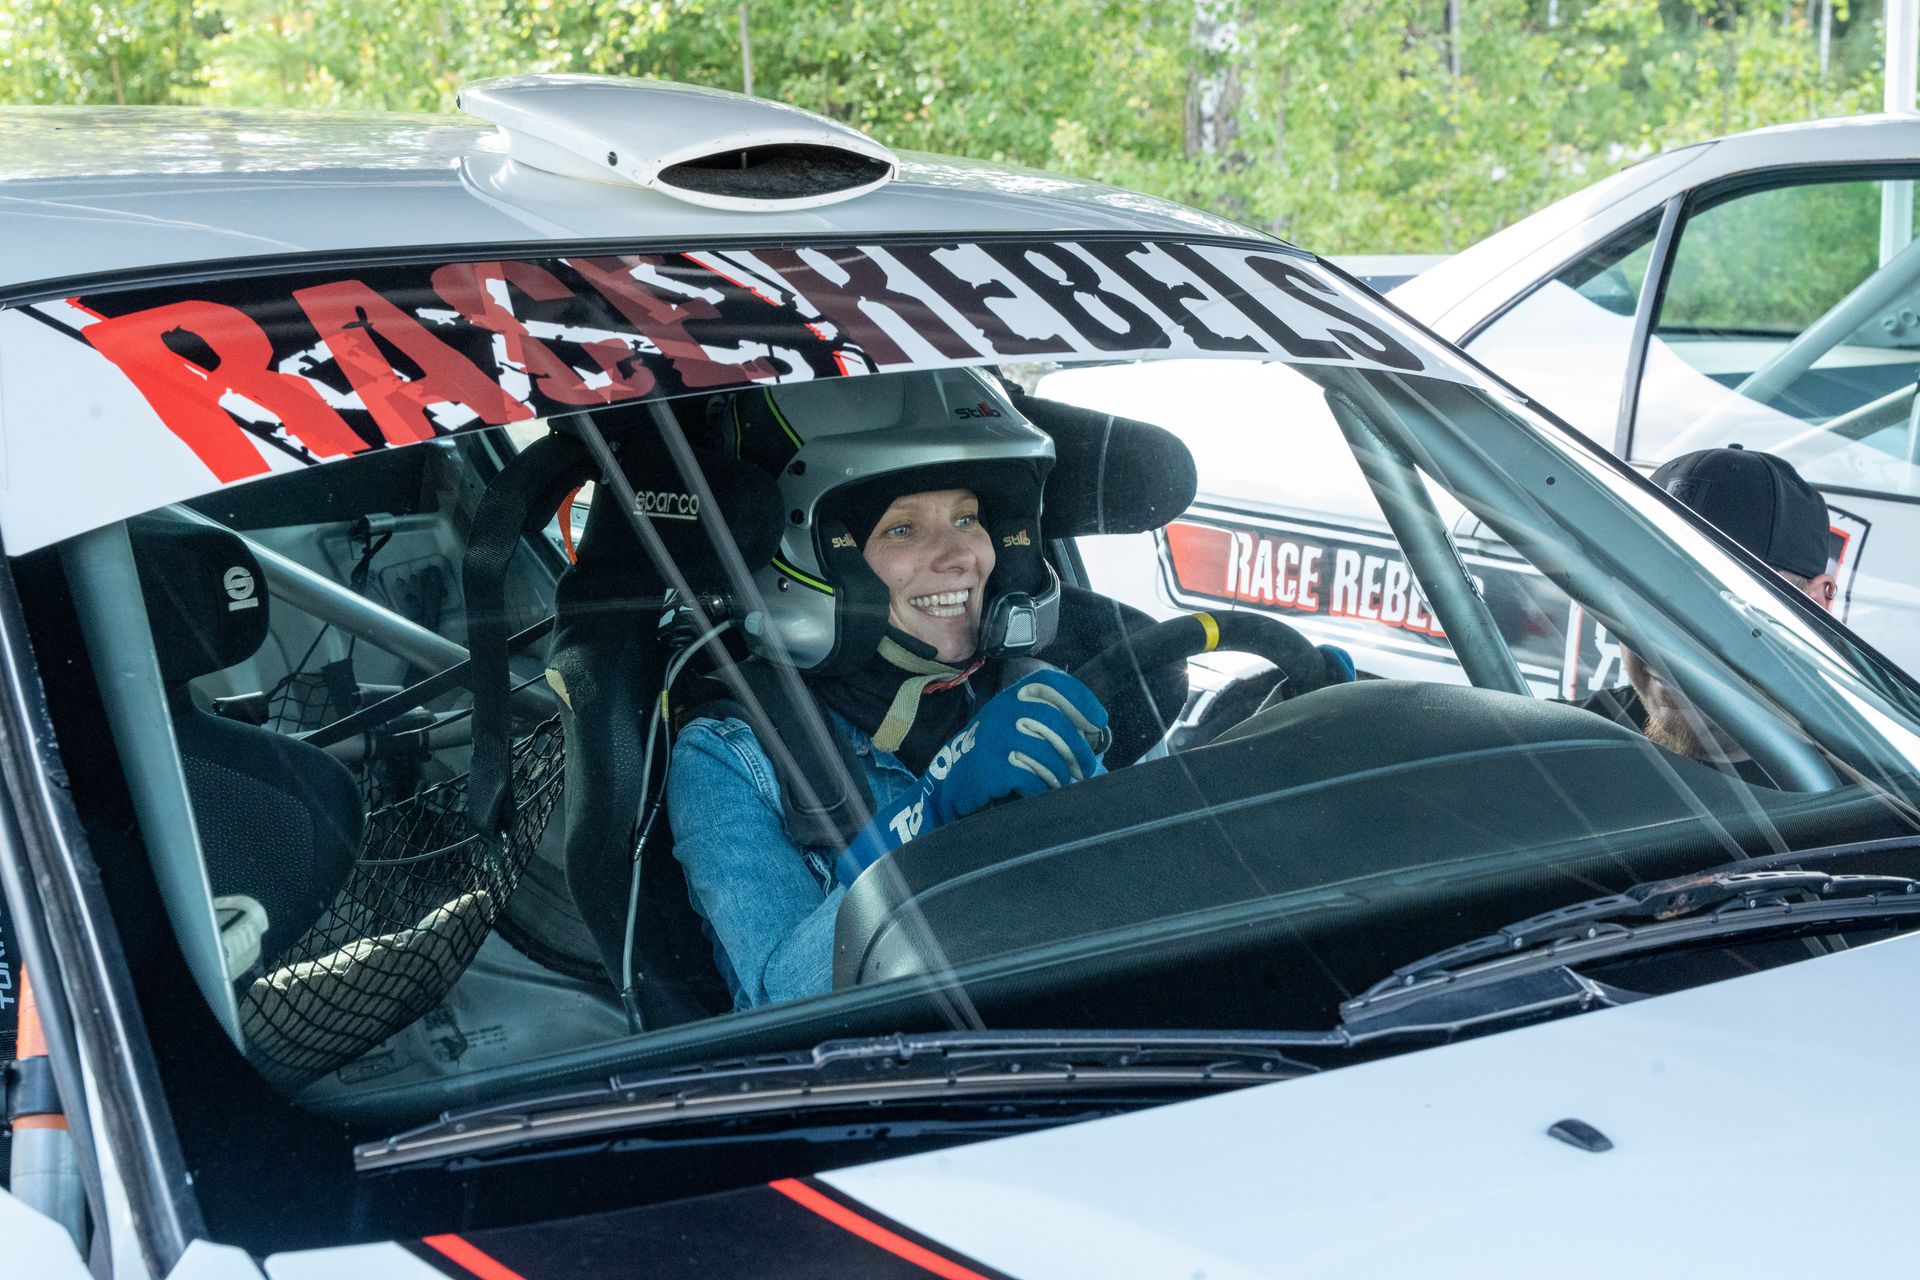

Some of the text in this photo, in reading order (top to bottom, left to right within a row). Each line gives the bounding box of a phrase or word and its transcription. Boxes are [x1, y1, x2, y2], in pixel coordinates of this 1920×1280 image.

[82, 242, 1426, 485] RACE REBELS
[635, 490, 700, 516] sparco
[1226, 531, 1323, 608] RACE
